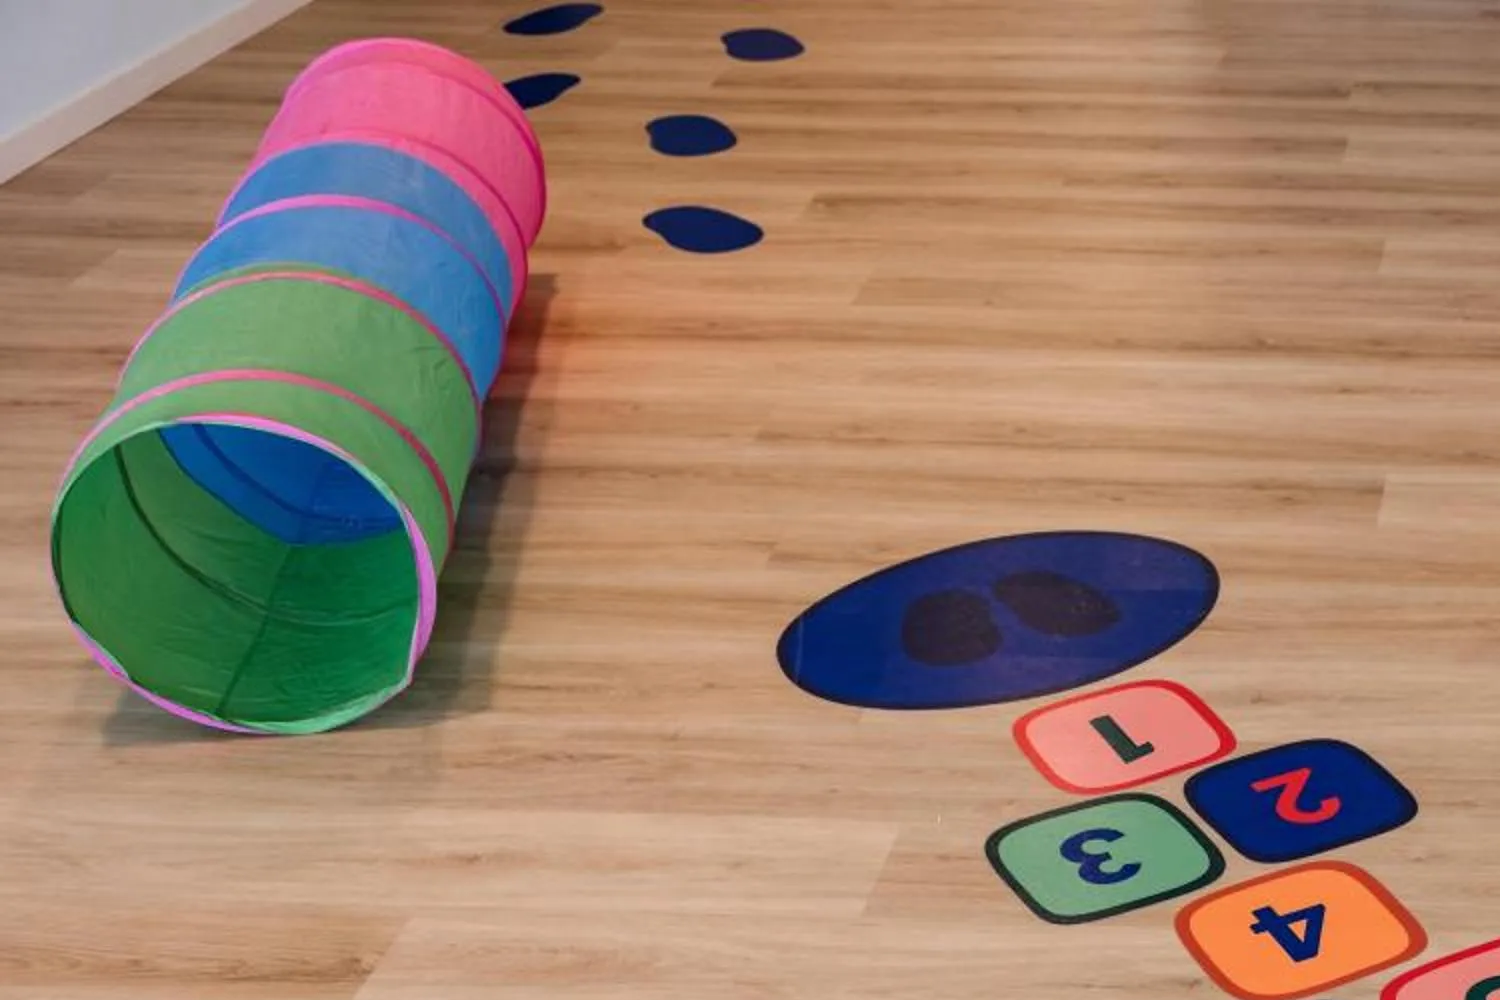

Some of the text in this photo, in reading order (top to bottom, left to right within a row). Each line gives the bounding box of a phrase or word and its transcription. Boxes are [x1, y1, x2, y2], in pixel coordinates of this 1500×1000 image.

[1090, 715, 1155, 764] 1
[1252, 767, 1340, 823] 2
[1059, 828, 1142, 885] 3
[1249, 903, 1326, 963] 4
